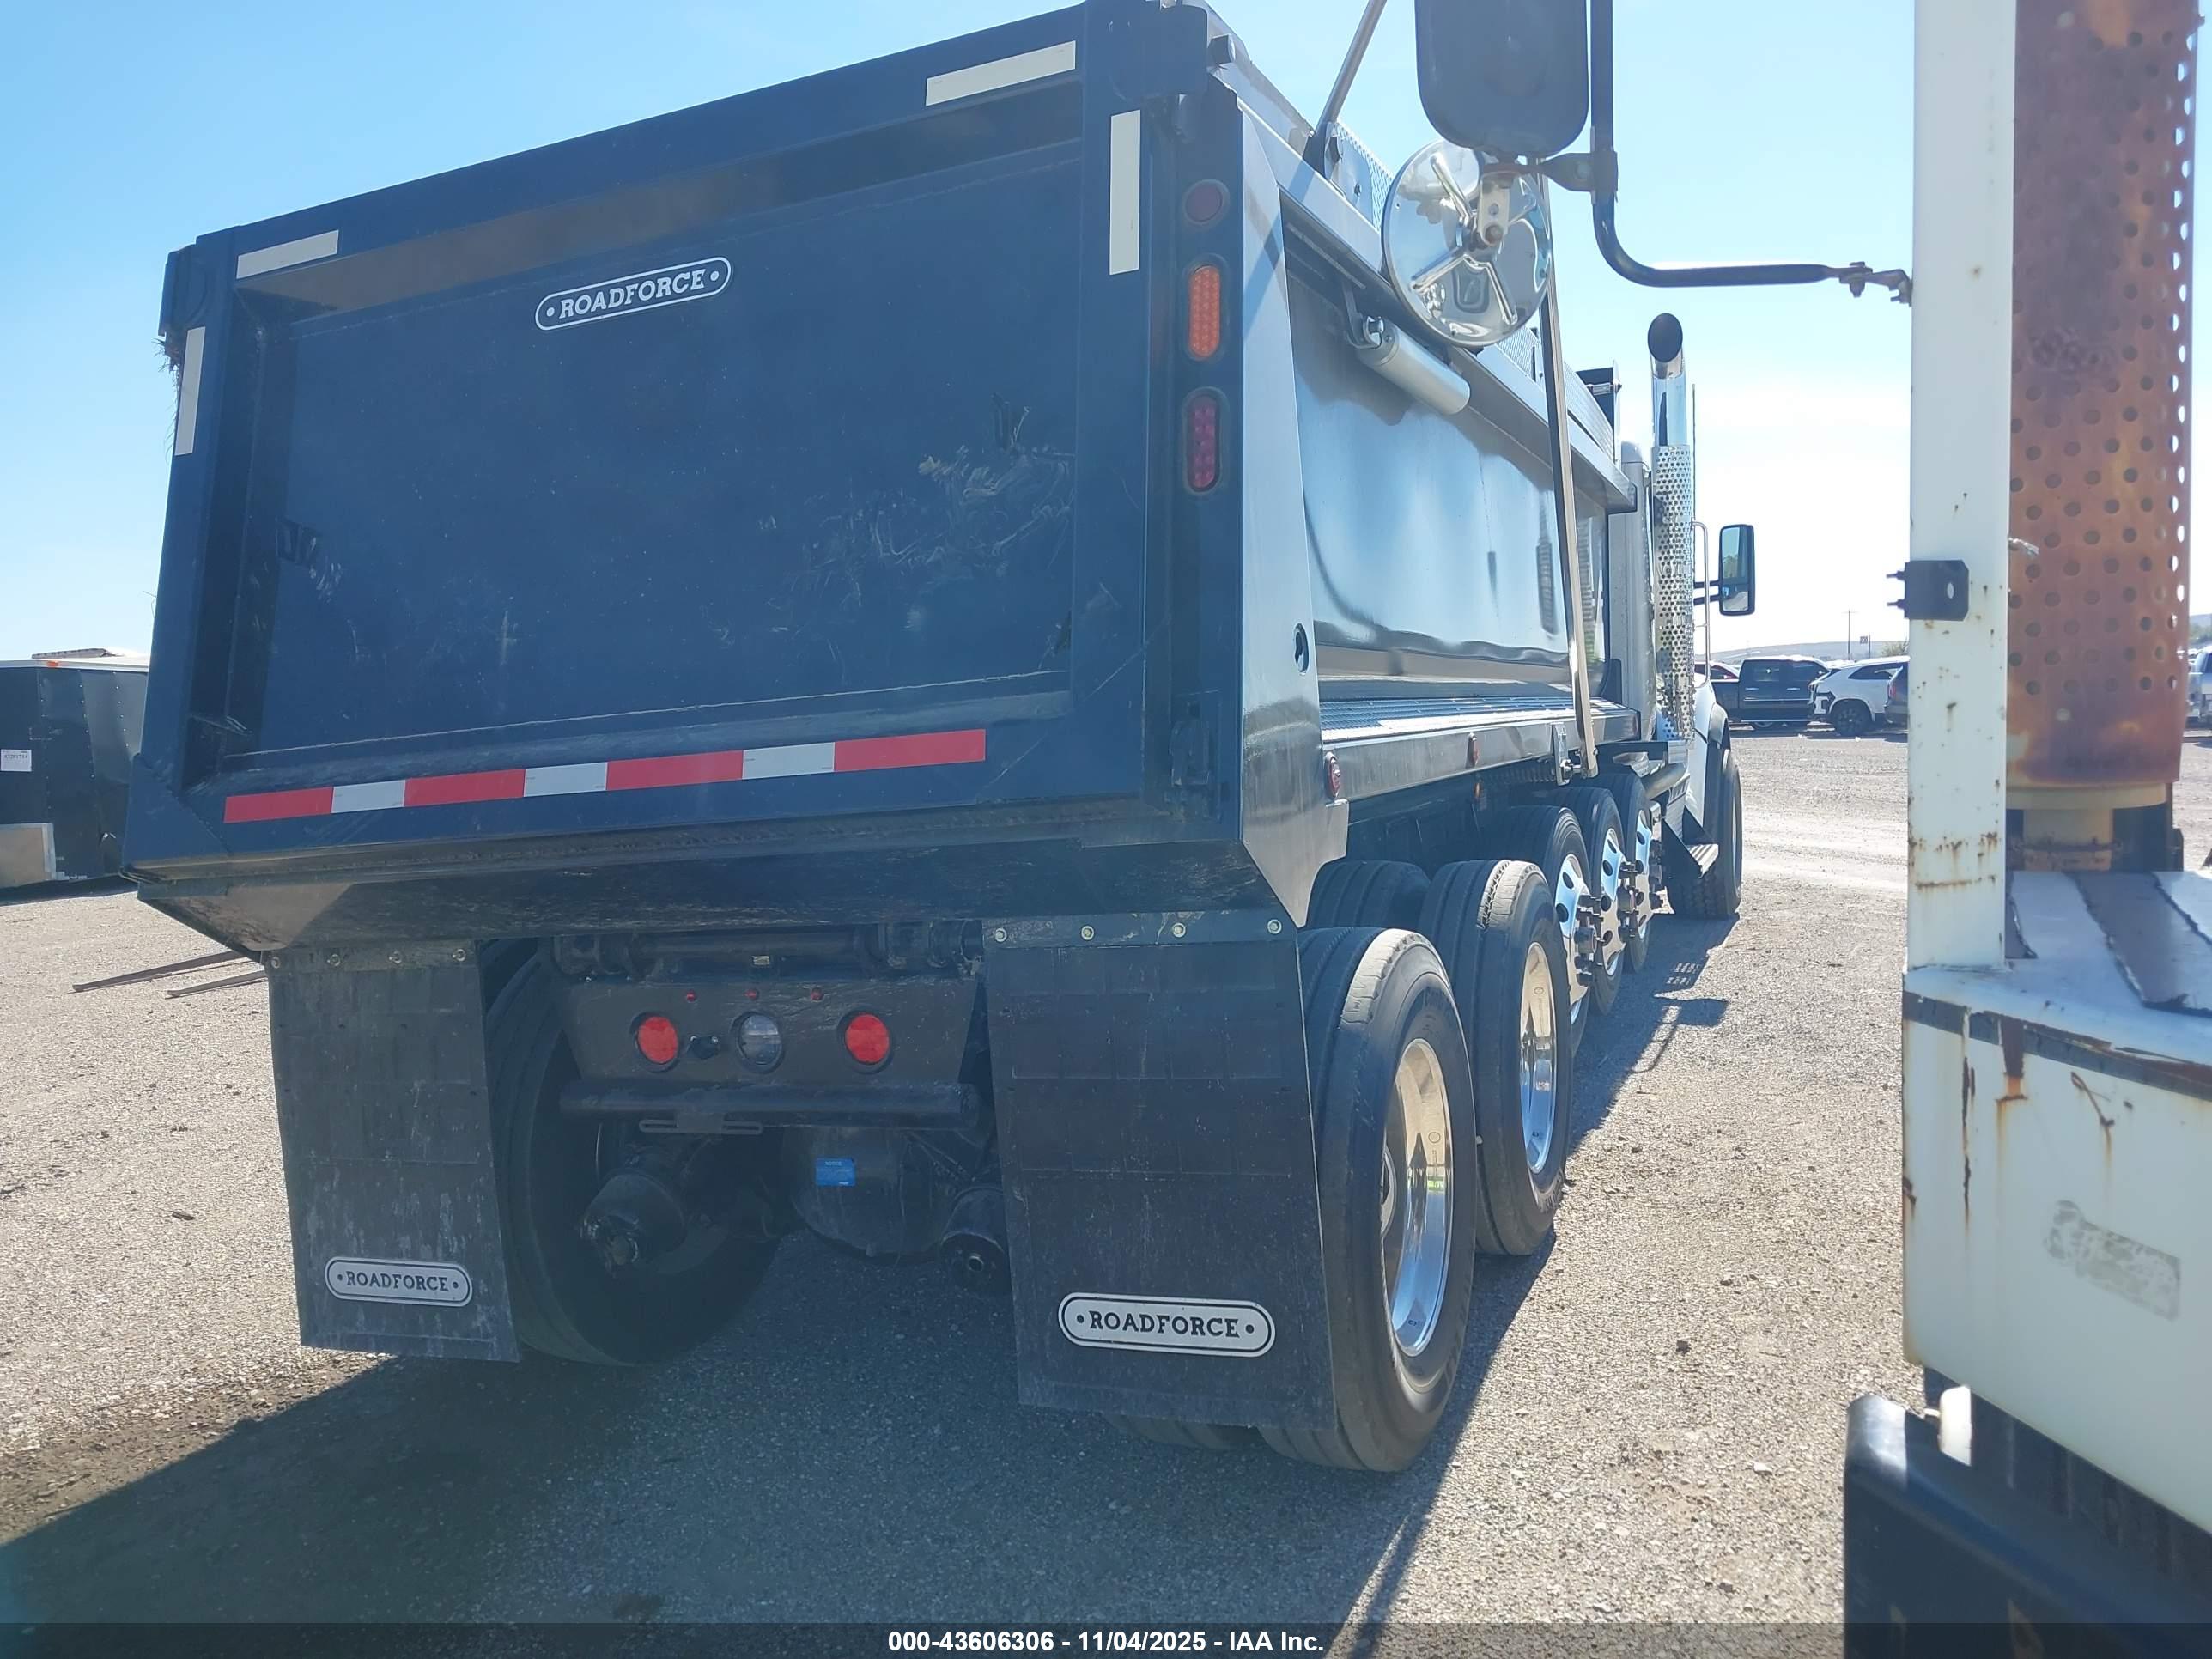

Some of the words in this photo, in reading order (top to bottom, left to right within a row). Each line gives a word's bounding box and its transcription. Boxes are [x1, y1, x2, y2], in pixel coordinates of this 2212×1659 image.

[559, 269, 706, 319] ROADFORCE
[346, 1271, 449, 1291] ROADFORCE
[1089, 1310, 1240, 1338] ROADFORCE
